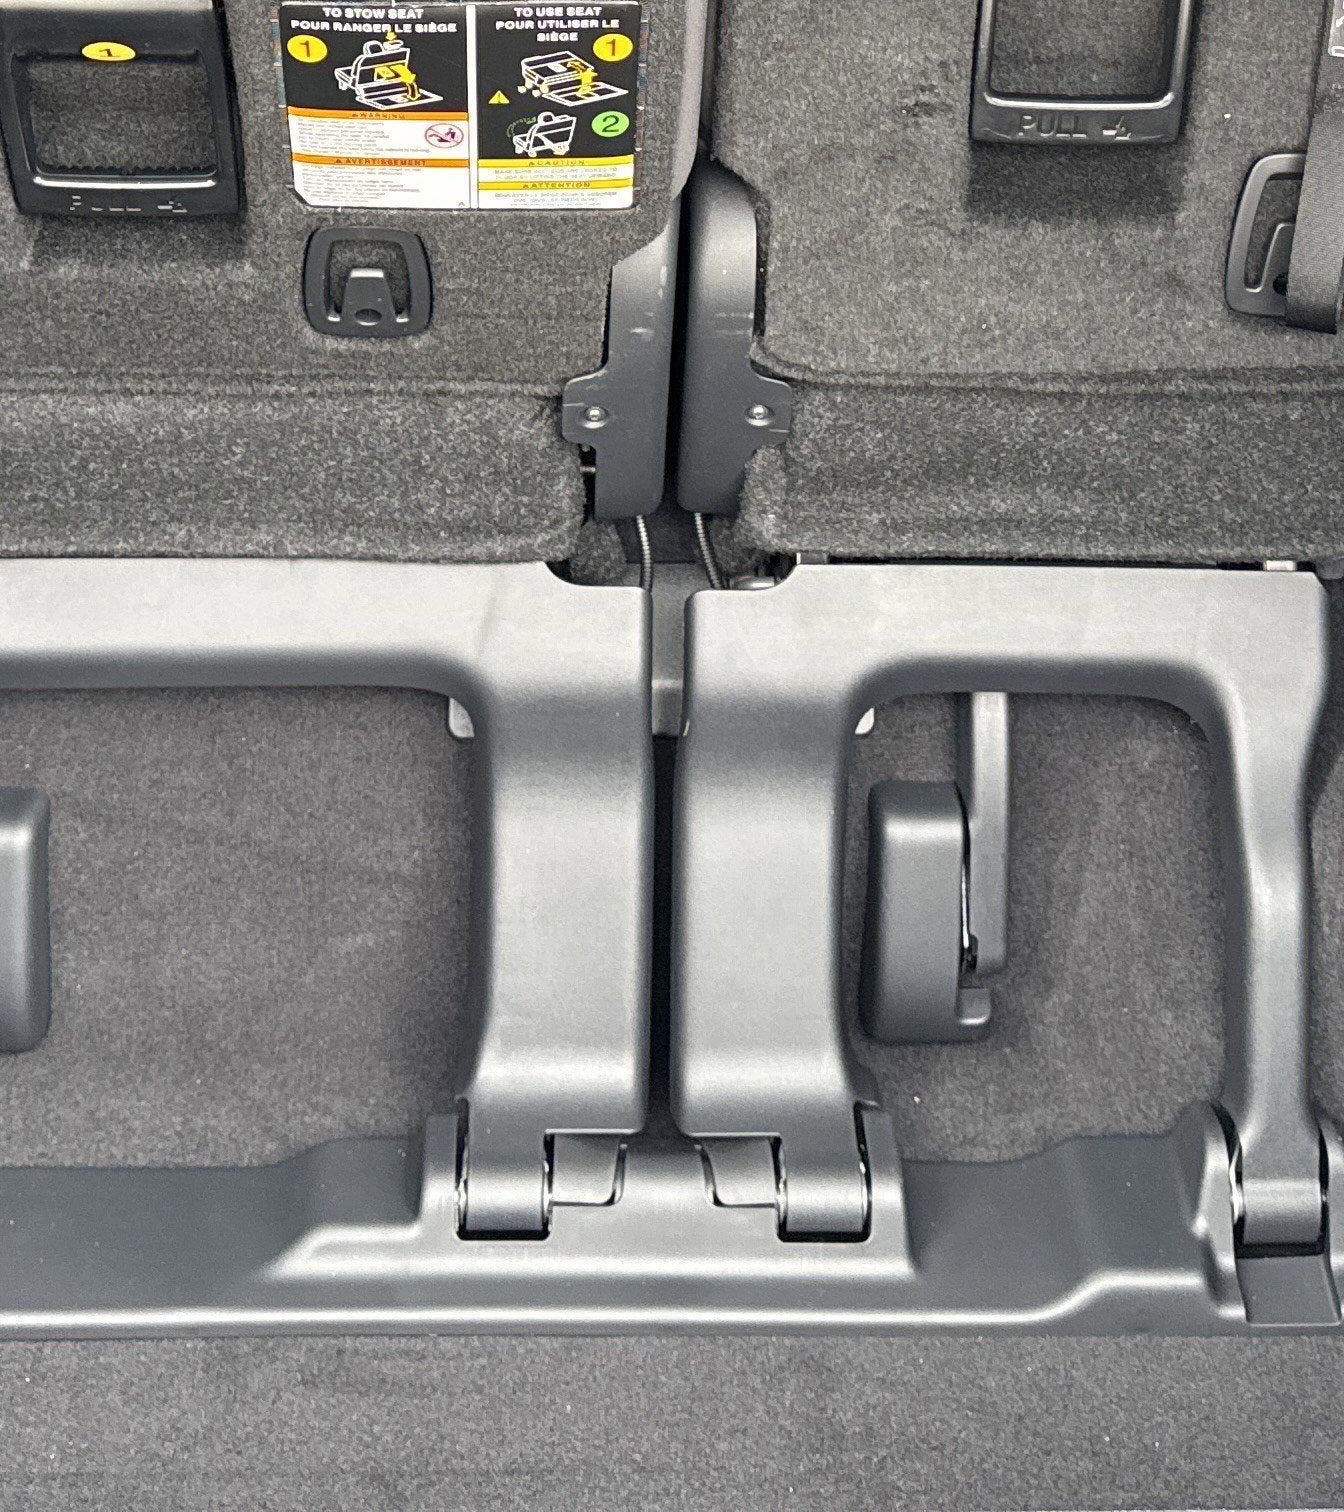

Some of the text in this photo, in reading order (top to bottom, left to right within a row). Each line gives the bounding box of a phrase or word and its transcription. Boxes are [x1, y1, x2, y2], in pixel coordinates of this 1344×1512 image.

[322, 7, 424, 20] TO STOW SEAT
[513, 6, 602, 18] TO USE SEAT
[290, 19, 458, 33] POUR RANGER LE SIÈGE
[495, 18, 620, 30] POUR UTILISER LE
[536, 31, 578, 42] SIÈGE
[299, 40, 311, 58] 1
[605, 38, 617, 57] 1
[601, 114, 620, 133] 2
[1019, 115, 1087, 138] PULL
[345, 158, 427, 167] AVERTISSEMENT
[531, 181, 591, 189] ATTENTION
